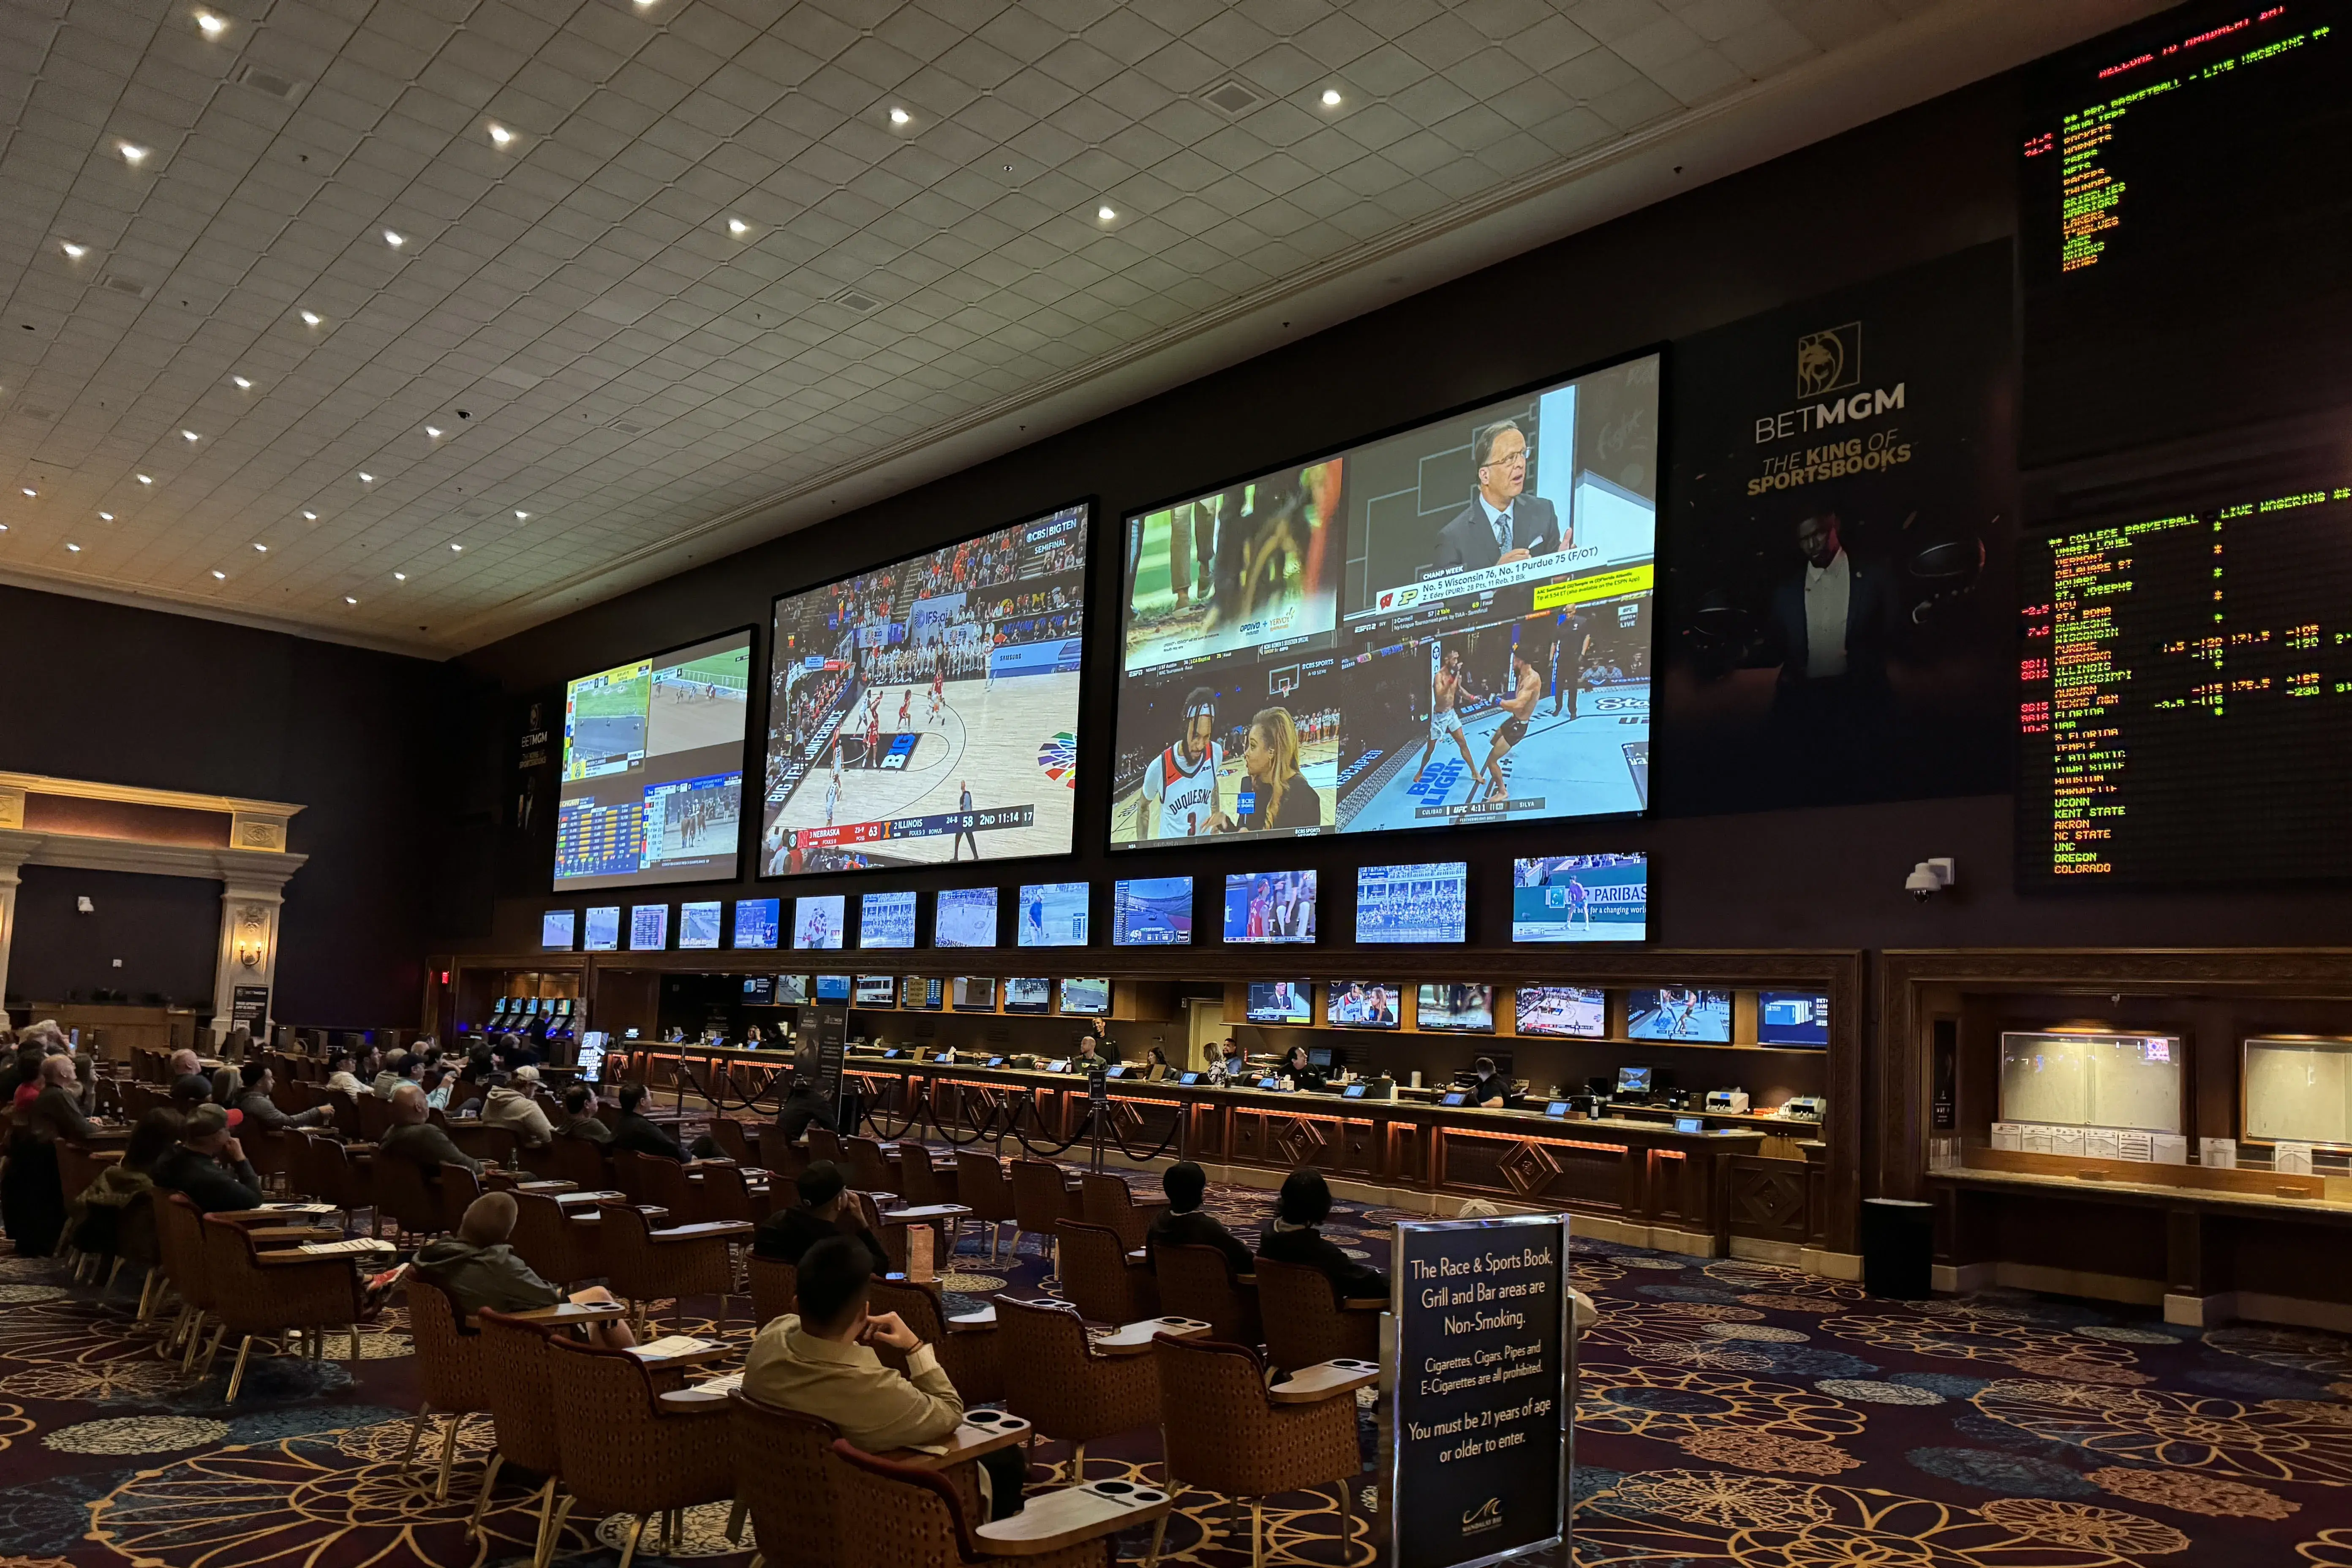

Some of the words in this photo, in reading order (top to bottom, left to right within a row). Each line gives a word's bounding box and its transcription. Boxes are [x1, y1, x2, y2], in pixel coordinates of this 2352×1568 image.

[2111, 78, 2182, 109] BASKETBALL
[2204, 59, 2235, 79] LIVE
[2063, 195, 2119, 220] WARRIORS
[2063, 210, 2105, 230] LAKERS
[2063, 254, 2098, 272] KINGS
[1756, 382, 1905, 444] BETMGM
[1763, 452, 1801, 476] THE
[1806, 438, 1861, 466] KING
[1868, 428, 1899, 452] OF
[1747, 444, 1911, 496] SPORTSBOOKS
[2069, 528, 2118, 544] COLLEGE
[2125, 513, 2199, 536] BASKETBALL
[2221, 503, 2253, 519] LIVE
[2259, 490, 2325, 512] WAGERING
[1032, 528, 1046, 541] CBS
[1049, 524, 1062, 536] BIG
[1062, 518, 1077, 531] TEN
[1034, 538, 1066, 555] SEMIFINAL
[1422, 571, 1445, 581] CHAMP
[1445, 565, 1464, 576] WEEK
[1423, 584, 1436, 592] No.
[1444, 572, 1484, 588] Wisconsin
[1499, 567, 1514, 576] No.
[1522, 557, 1553, 571] Purdue
[1555, 554, 1566, 564] 75
[1568, 546, 1598, 562] (F/OT)
[2118, 559, 2133, 570] ST
[1429, 590, 1445, 599] Edey
[2083, 581, 2133, 597] JOSEPHS
[1240, 621, 1260, 632] OPDIVO
[1269, 616, 1290, 626] YERVOY
[1396, 615, 1413, 623] Cornell
[1400, 622, 1414, 630] League
[1414, 617, 1438, 627] Tournament
[2055, 627, 2118, 644] WISCONSIN
[2055, 641, 2097, 655] PURDUE
[2055, 651, 2111, 666] NEBRASKA
[2056, 662, 2111, 677] ILLINOIS
[2055, 670, 2132, 688] MISSISSIPPI
[2055, 685, 2097, 698] AUBURN
[2055, 697, 2090, 710] TEXAS
[2096, 693, 2119, 705] A&M
[2055, 742, 2096, 751] TEMPLE
[1406, 762, 1445, 795] BUD
[1421, 757, 1467, 806] LIGHT
[1168, 788, 1211, 815] DUQUESNE
[1454, 806, 1468, 814] UFC
[1471, 804, 1486, 812] 4:11
[2055, 797, 2090, 808] UCONN
[2054, 808, 2082, 819] KENT
[2089, 806, 2126, 817] STATE
[813, 828, 840, 838] NEBRASKA
[868, 825, 877, 837] 63
[898, 819, 923, 829] ILLINOIS
[962, 815, 974, 828] 58
[980, 814, 996, 825] 2ND
[998, 811, 1019, 824] 11:14
[1024, 811, 1032, 822] 17
[2054, 819, 2090, 830] AKRON
[2054, 832, 2069, 841] NC
[2075, 829, 2111, 839] STATE
[2054, 842, 2076, 852] UNC
[2054, 852, 2097, 863] OREGON
[2054, 863, 2111, 874] COLORADO
[1595, 885, 1647, 902] PARIBAS
[1590, 906, 1598, 915] for
[1603, 906, 1629, 915] changing
[1411, 1260, 1437, 1279] The
[1440, 1257, 1470, 1277] Race
[1473, 1257, 1482, 1273] &
[1486, 1252, 1521, 1276] Sports
[1421, 1287, 1448, 1309] Grill
[1451, 1284, 1474, 1305] and
[1477, 1282, 1496, 1302] Bar
[1499, 1284, 1527, 1299] areas
[1529, 1281, 1546, 1294] are
[1444, 1309, 1526, 1336] Non-Smoking.
[1504, 1345, 1526, 1361] Pipes
[1527, 1339, 1541, 1355] and
[1421, 1376, 1476, 1395] E-Cigarettes
[1478, 1374, 1491, 1385] are
[1492, 1367, 1502, 1382] all
[1503, 1359, 1544, 1384] prohibited.
[1408, 1421, 1431, 1441] You
[1434, 1418, 1462, 1436] must
[1465, 1412, 1479, 1430] be
[1481, 1410, 1492, 1427] 21
[1494, 1406, 1520, 1428] years
[1522, 1397, 1533, 1417] of
[1534, 1399, 1551, 1416] age
[1440, 1449, 1451, 1463] or
[1455, 1440, 1483, 1459] older
[1485, 1440, 1496, 1452] to
[1499, 1432, 1526, 1448] enter.
